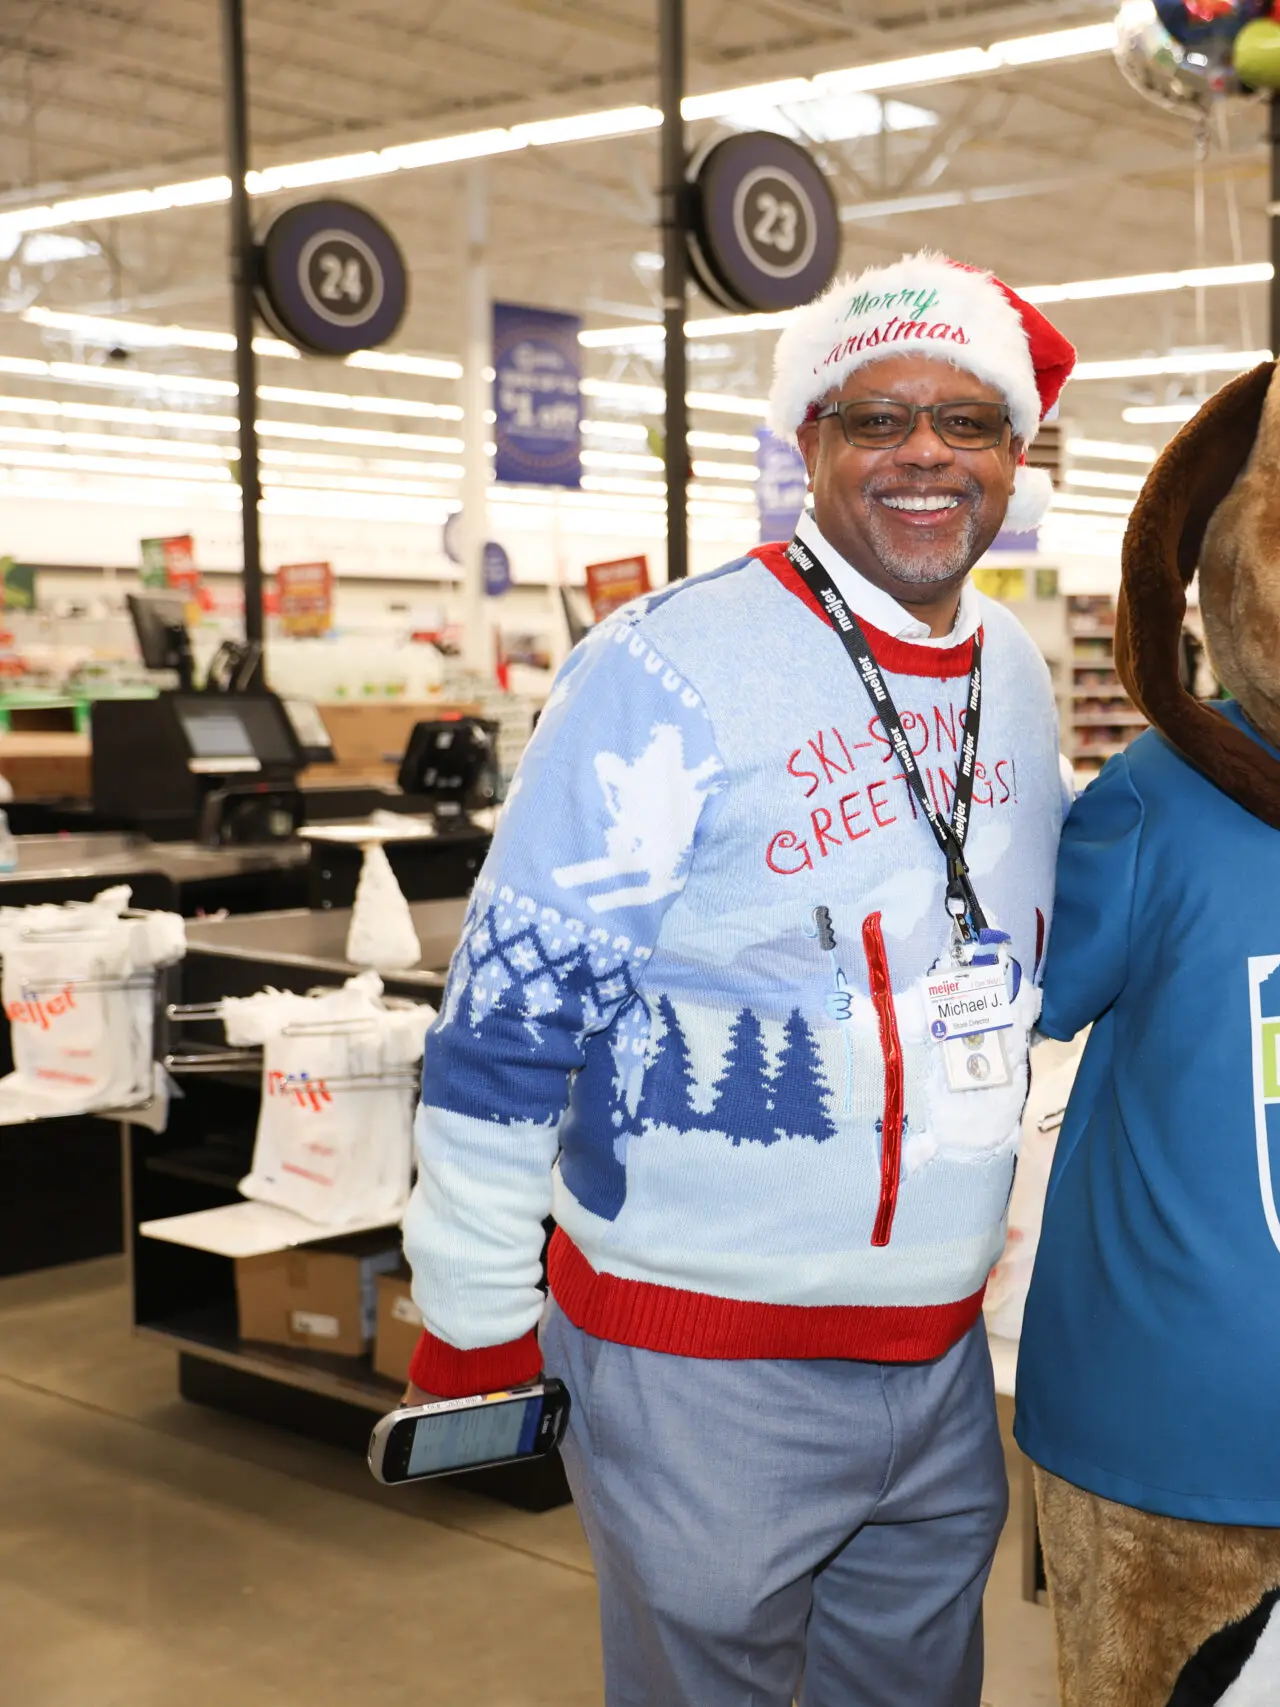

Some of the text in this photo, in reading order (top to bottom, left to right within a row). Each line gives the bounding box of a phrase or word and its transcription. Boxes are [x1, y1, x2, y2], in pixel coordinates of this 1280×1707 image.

[754, 193, 797, 251] 23
[320, 253, 363, 303] 24
[845, 288, 940, 321] Merry
[813, 316, 971, 374] ristmas
[787, 541, 814, 572] meije
[820, 587, 854, 632] meijer
[858, 655, 888, 702] meijer
[961, 731, 976, 777] meijer
[970, 666, 981, 712] meijer
[889, 727, 915, 773] meijer
[5, 982, 76, 1031] eijer
[928, 980, 960, 996] meijer
[938, 995, 988, 1019] Michael
[991, 993, 1003, 1008] J.
